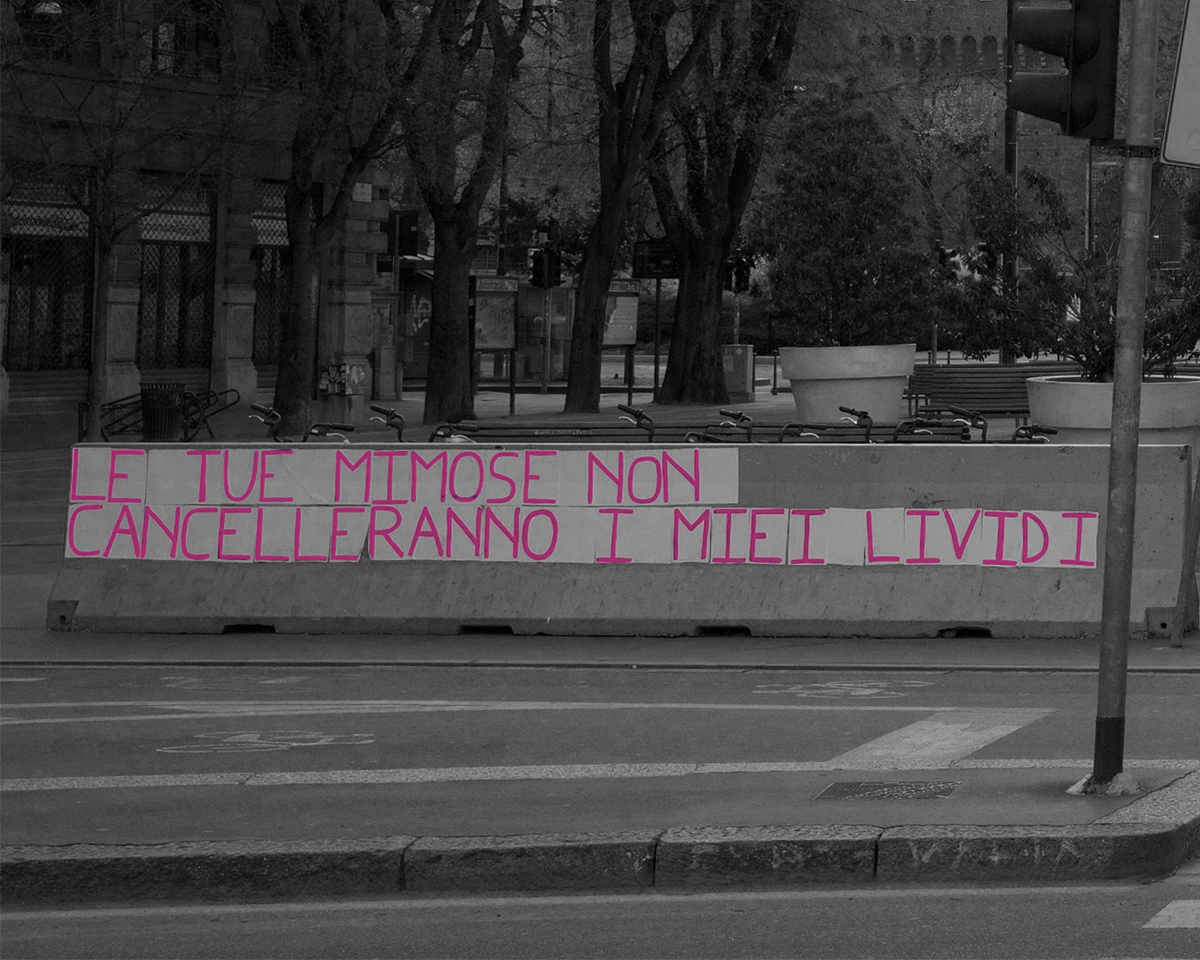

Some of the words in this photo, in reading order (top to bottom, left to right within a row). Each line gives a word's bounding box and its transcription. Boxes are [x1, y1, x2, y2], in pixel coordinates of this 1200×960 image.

[70, 449, 145, 503] LE
[187, 450, 294, 502] TUE
[335, 450, 557, 504] MIMOSE
[587, 449, 700, 504] NON
[68, 504, 558, 561] CANCELLERANNO
[597, 509, 634, 563] I
[673, 508, 825, 564] MIEI
[866, 510, 1097, 566] LIVIDI
